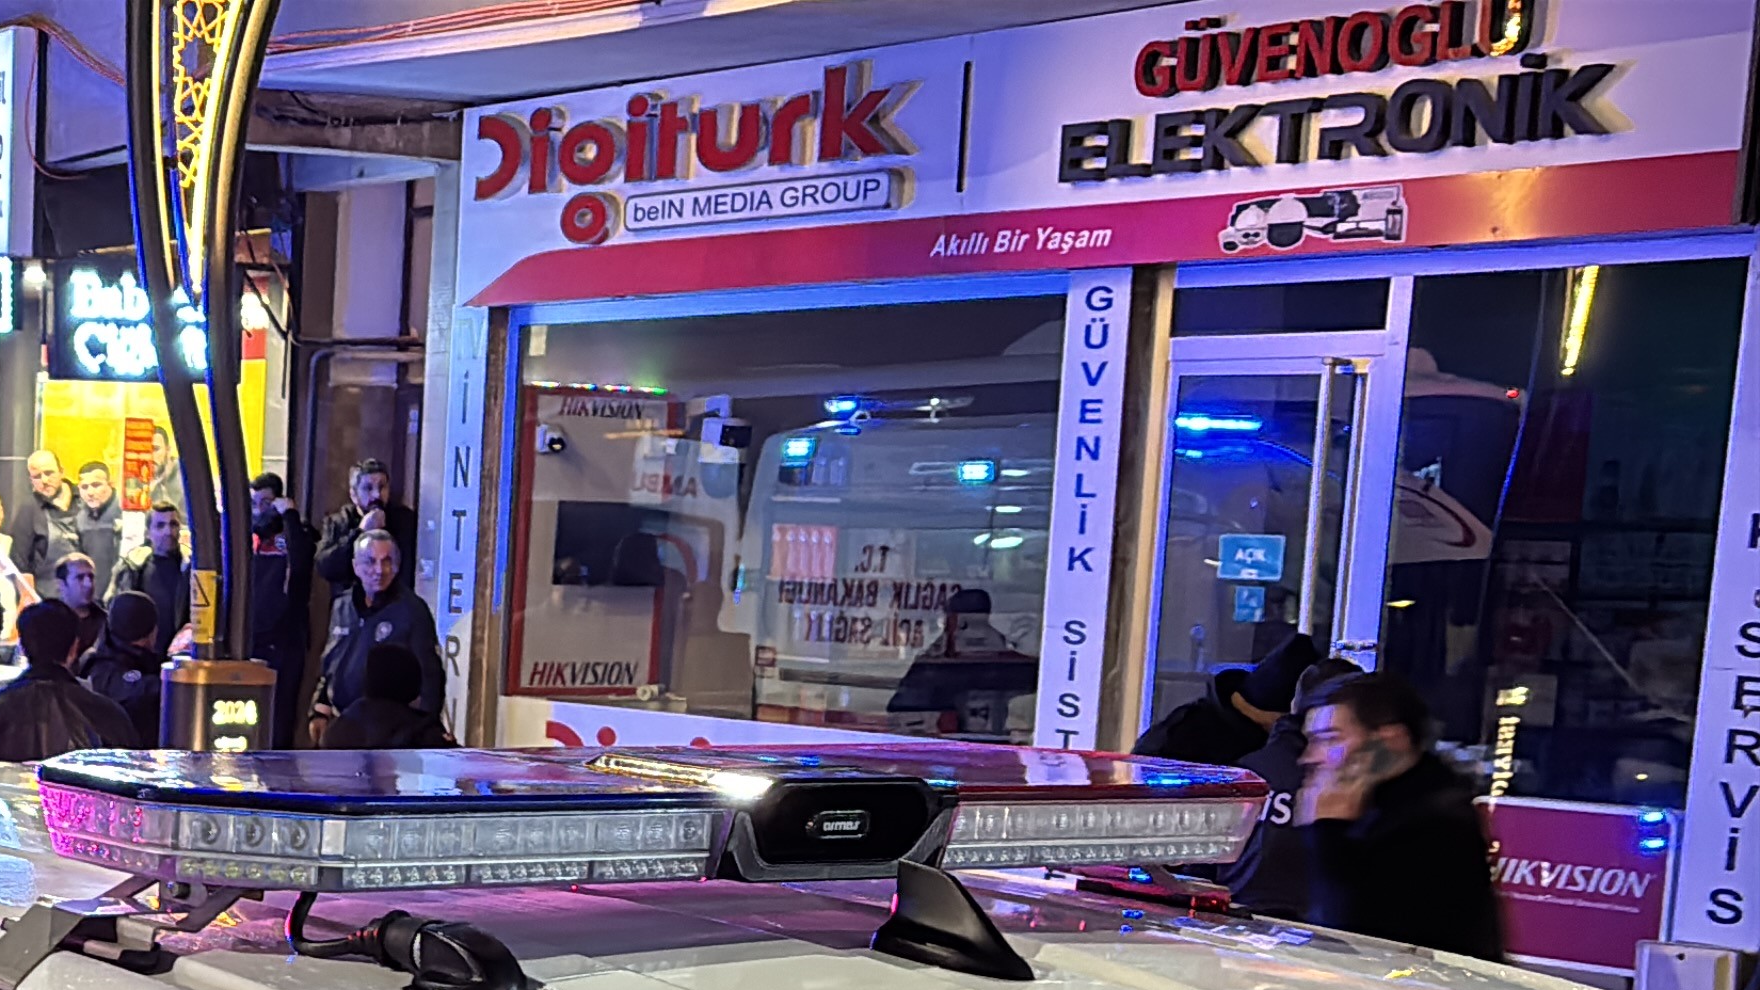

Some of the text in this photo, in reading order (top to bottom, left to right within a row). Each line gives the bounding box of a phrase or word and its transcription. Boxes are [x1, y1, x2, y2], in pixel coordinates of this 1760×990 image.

[1058, 53, 1625, 183] ELEKTRONİK
[633, 178, 881, 222] beIN MEDIA GROUP
[930, 226, 1113, 257] Akıllı Bir Yaşam
[559, 396, 646, 421] HIKVISION
[1067, 285, 1114, 573] GÜVENLİK
[529, 660, 639, 687] HIKVISION
